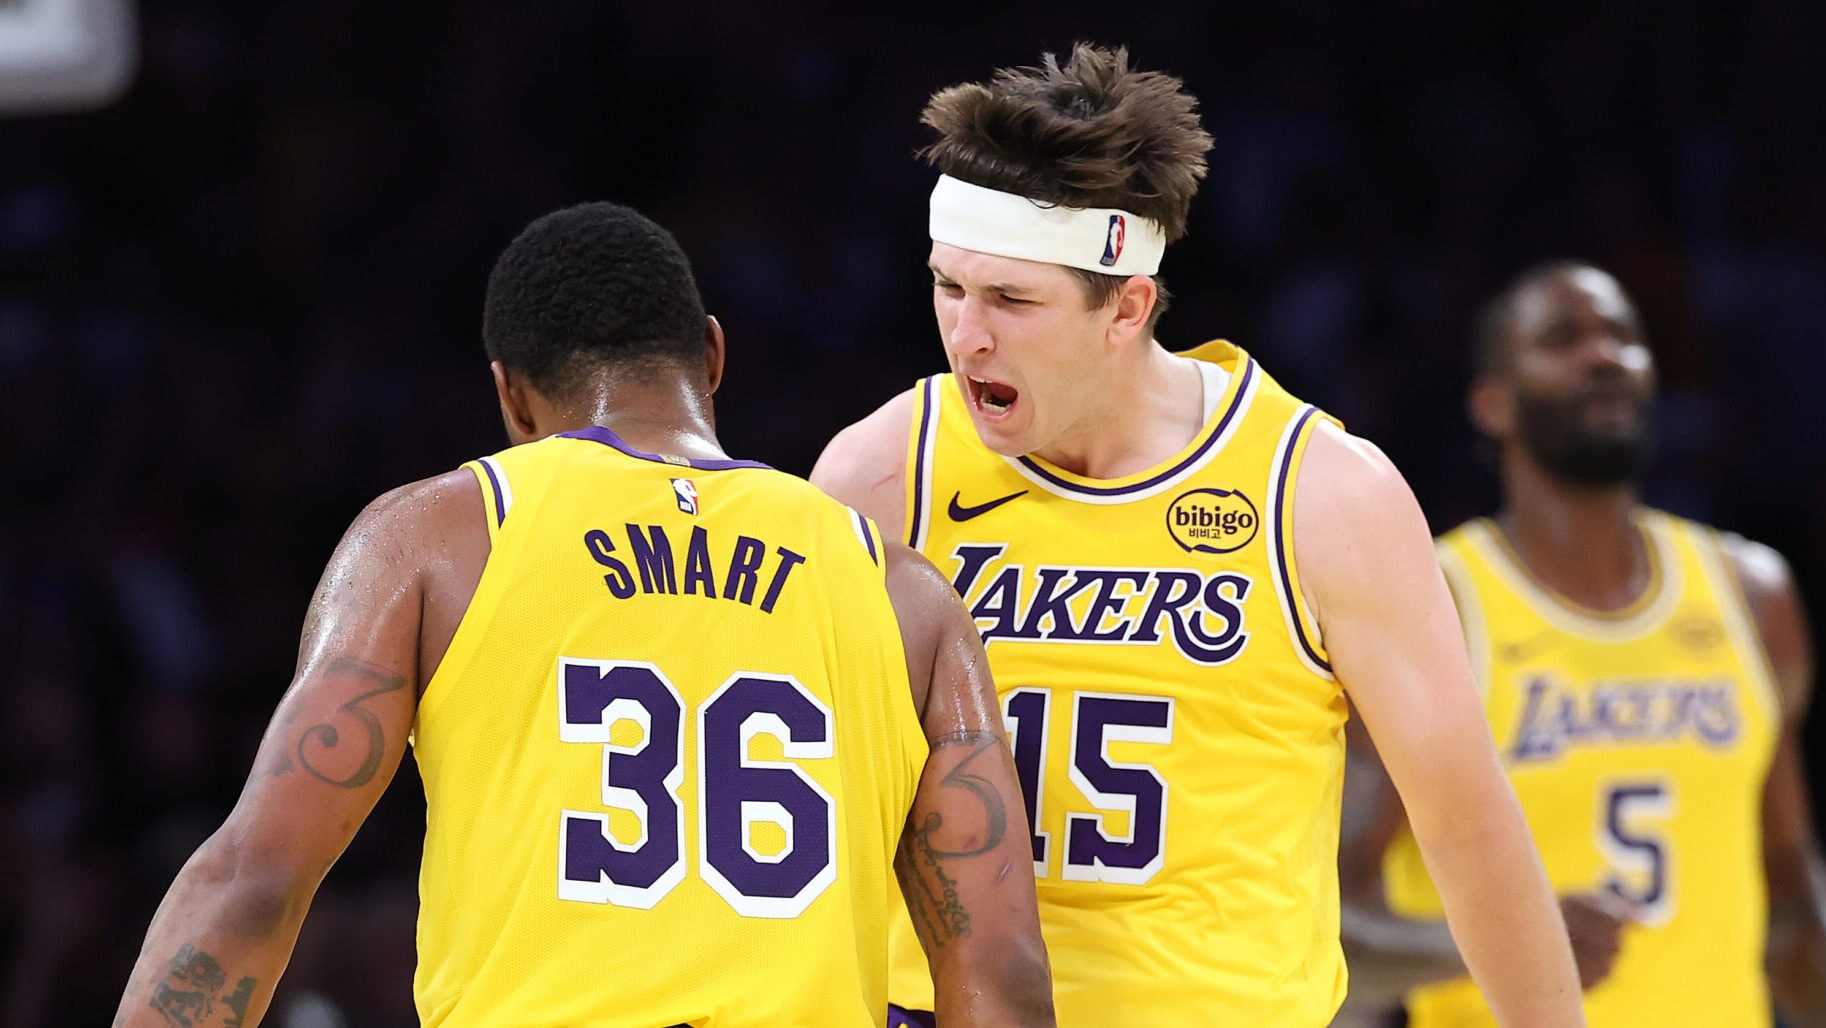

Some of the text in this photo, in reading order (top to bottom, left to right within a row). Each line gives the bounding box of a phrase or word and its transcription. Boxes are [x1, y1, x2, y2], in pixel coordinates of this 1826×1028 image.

[584, 523, 806, 614] SMART
[1176, 505, 1253, 535] bibigo
[1189, 528, 1221, 539] 비비고
[951, 542, 1254, 667] LAKERS
[558, 656, 837, 919] 36
[1002, 686, 1175, 884] 15
[1601, 780, 1671, 918] 5
